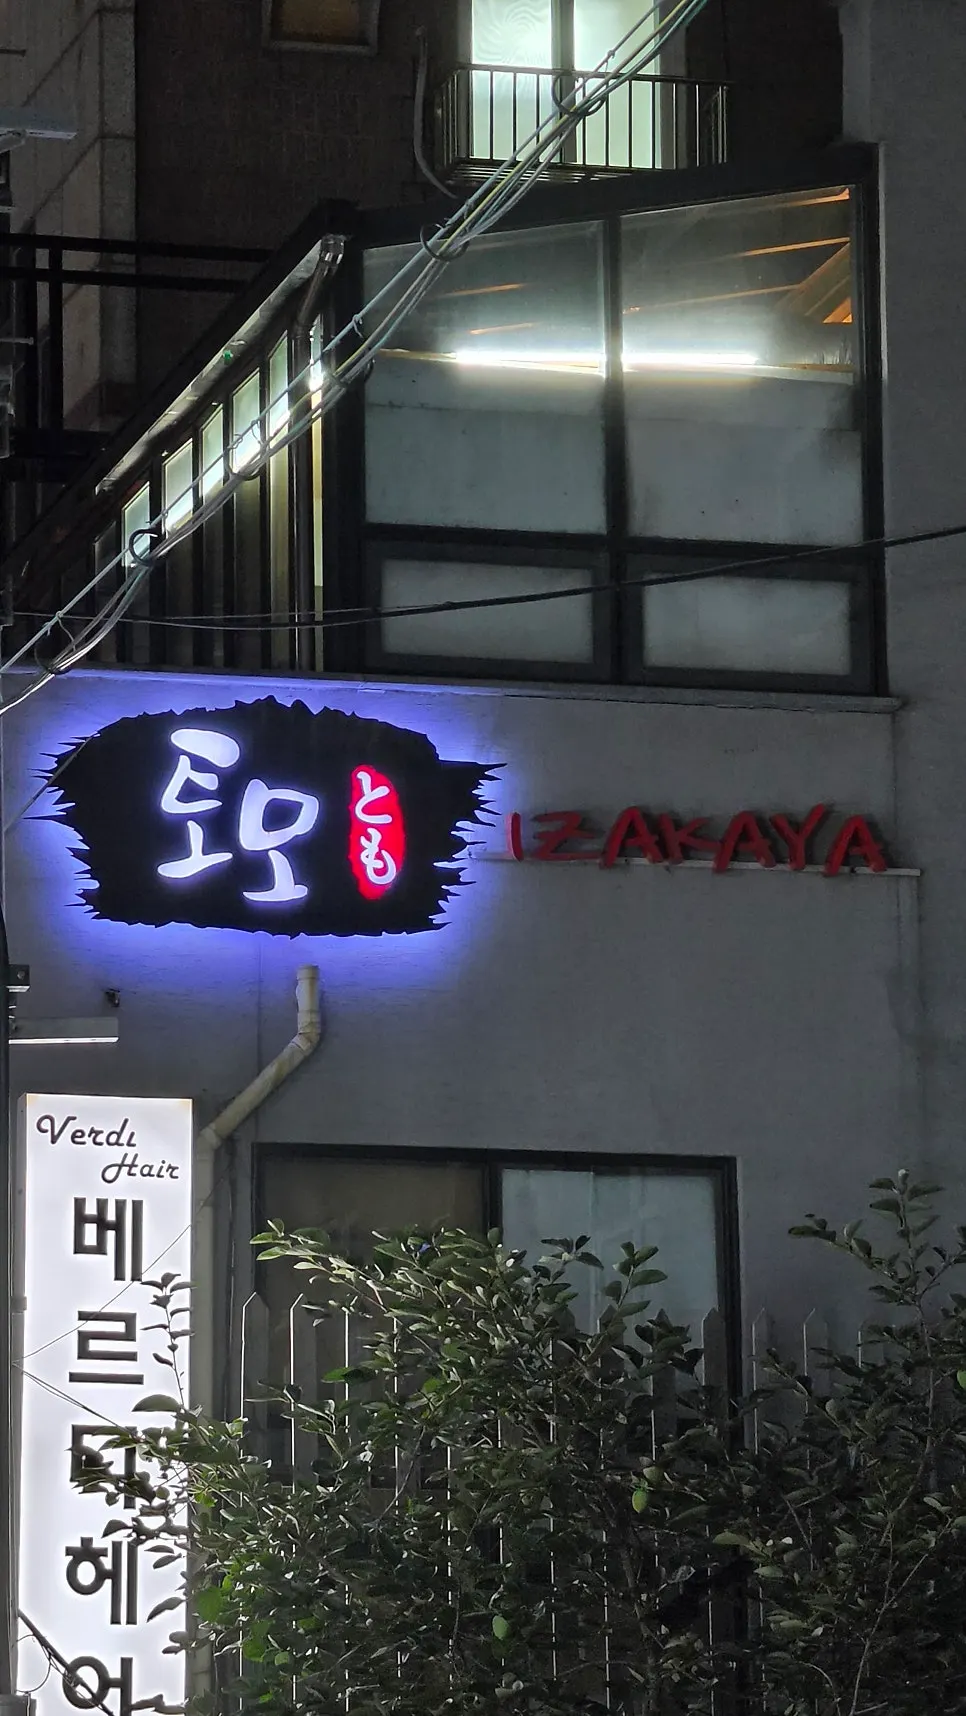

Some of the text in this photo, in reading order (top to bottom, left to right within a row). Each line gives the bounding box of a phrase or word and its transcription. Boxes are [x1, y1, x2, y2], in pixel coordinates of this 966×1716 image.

[157, 728, 320, 902] 토모
[356, 771, 397, 885] とも
[506, 803, 888, 877] IZAKAYA
[36, 1114, 137, 1147] Verdi
[101, 1152, 180, 1183] Hair
